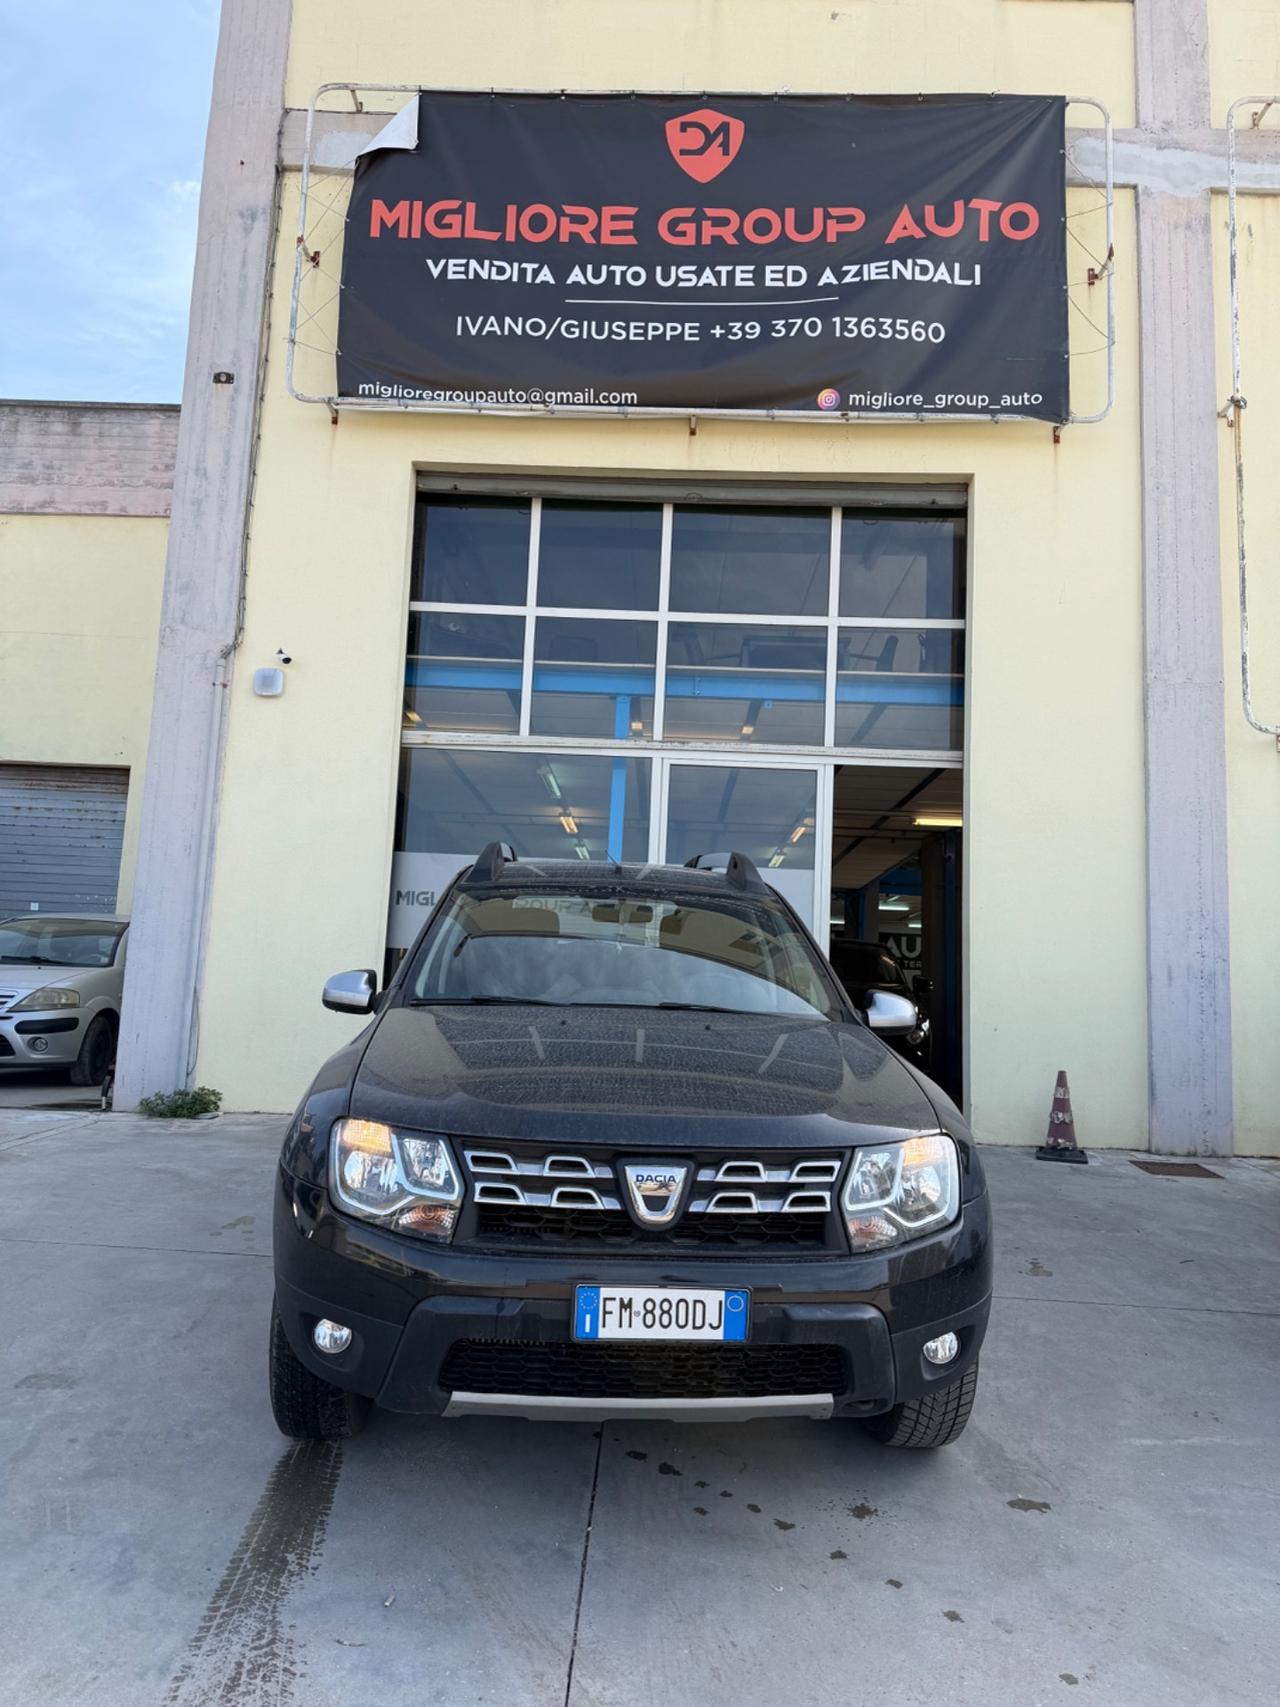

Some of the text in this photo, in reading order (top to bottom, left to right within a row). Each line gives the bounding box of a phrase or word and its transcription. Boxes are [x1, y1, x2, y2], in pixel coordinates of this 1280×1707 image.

[370, 199, 1039, 246] MIGLIORE GROUP AUTO
[425, 258, 981, 287] VENDITA AUTO USATE ED AZIENDALI
[456, 315, 946, 344] IVANO/GIUSEPPE +39 370 1363560
[358, 382, 638, 406] miglioregroupauto@gmail.com
[849, 390, 1043, 409] migliore_group_auto
[635, 1174, 677, 1184] DACIA
